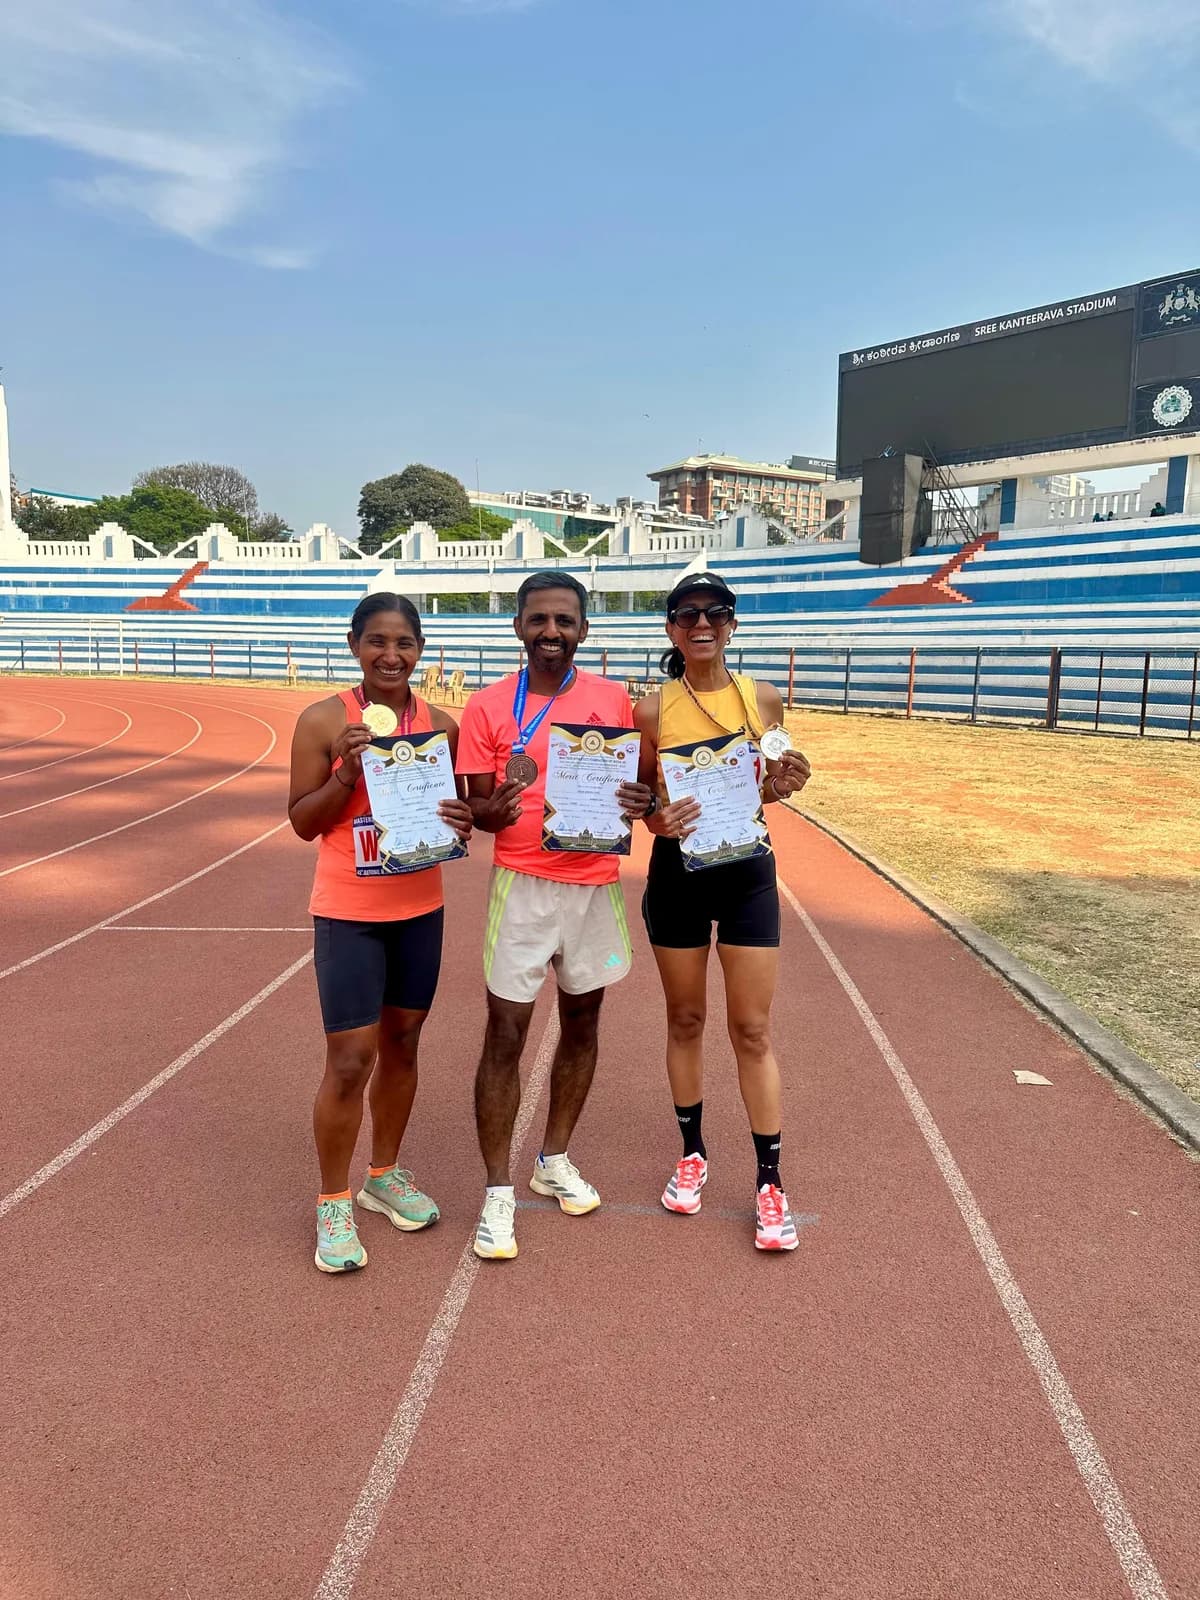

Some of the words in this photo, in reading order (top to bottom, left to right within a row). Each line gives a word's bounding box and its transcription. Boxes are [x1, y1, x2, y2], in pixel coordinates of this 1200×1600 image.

[974, 323, 997, 337] SREE
[999, 308, 1064, 332] KANTEERAVA
[1066, 295, 1117, 316] STADIUM
[852, 353, 864, 366] ಶ್ರೀ
